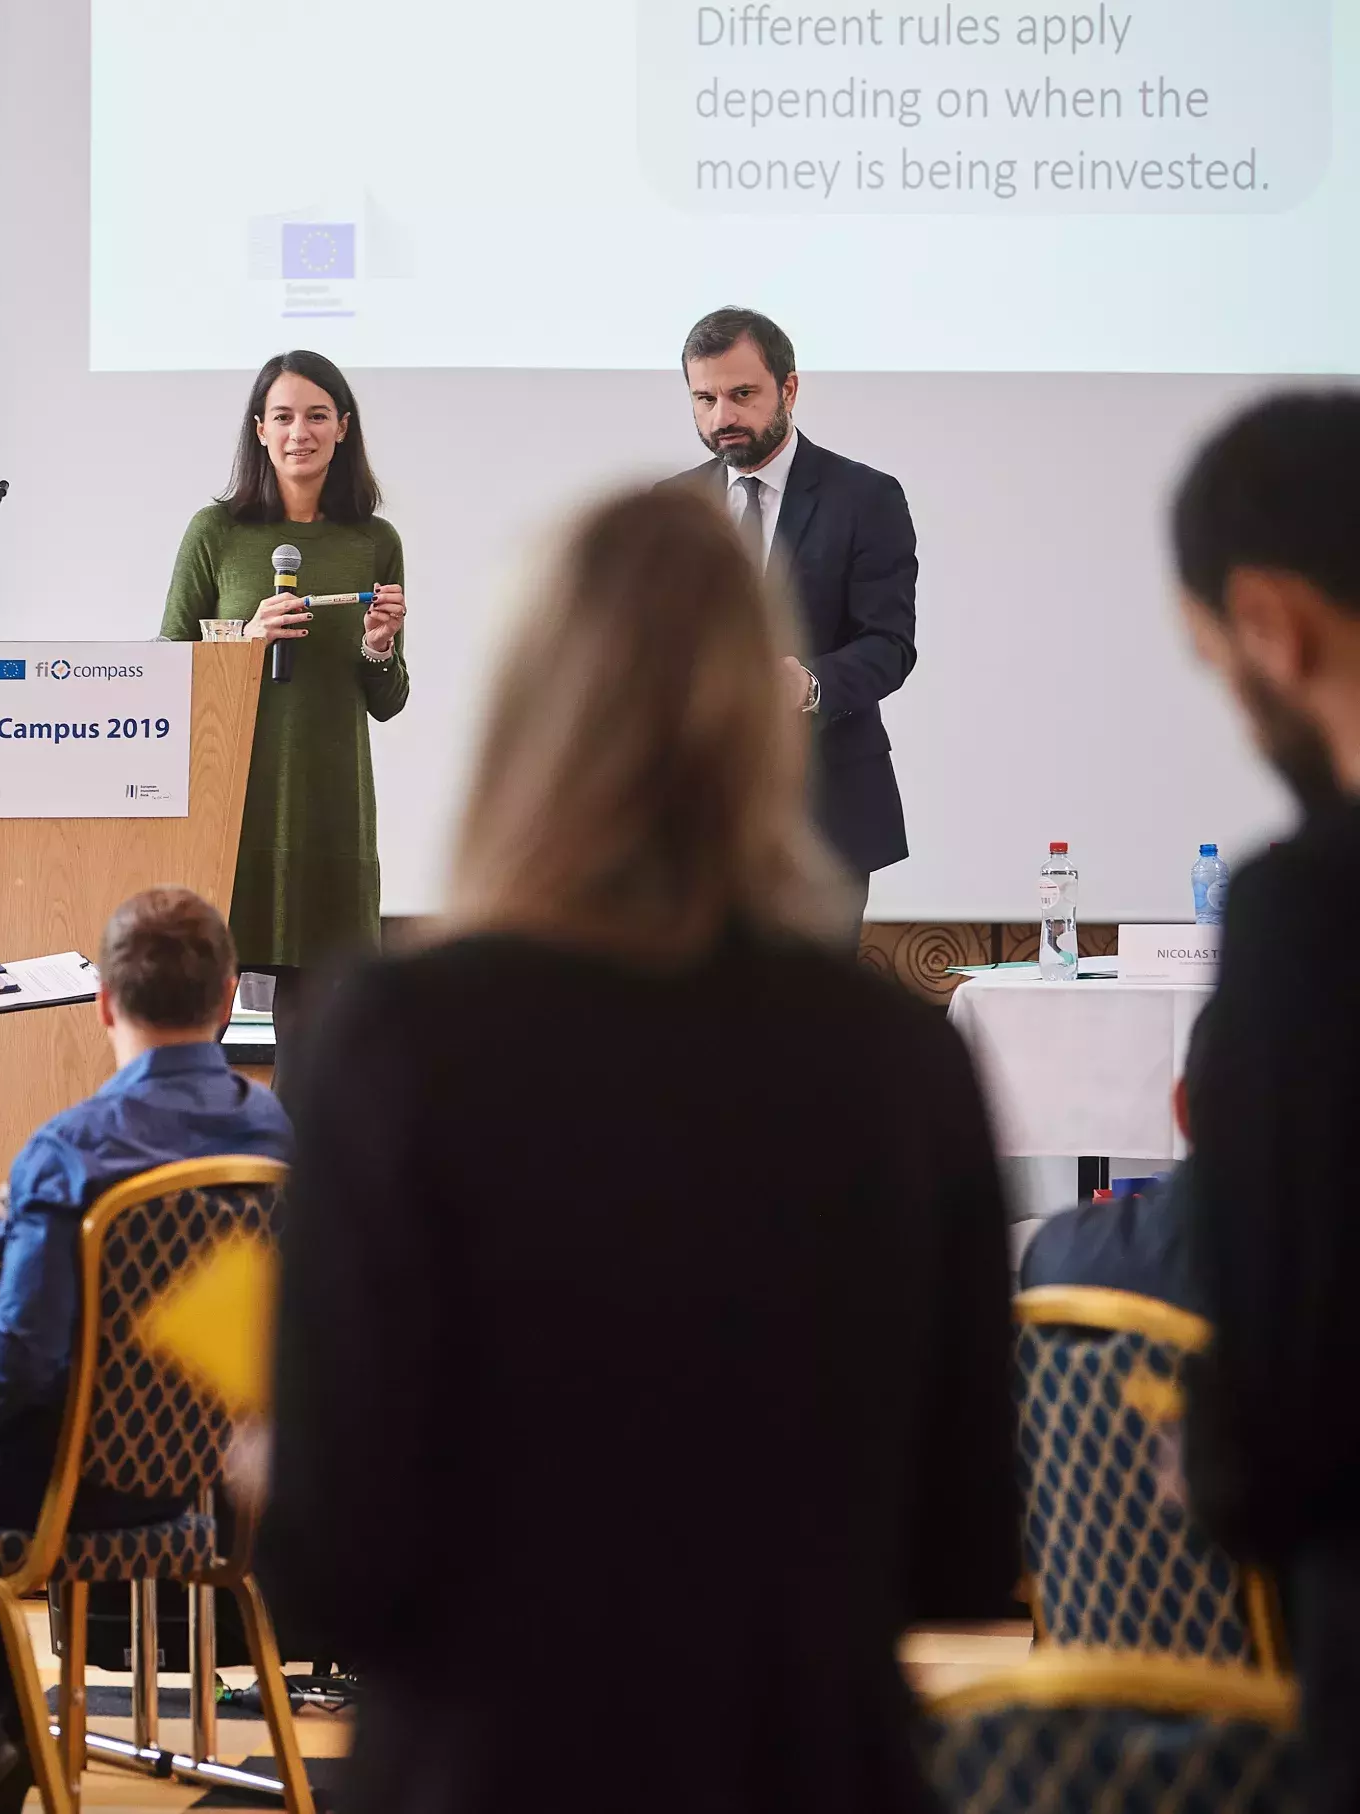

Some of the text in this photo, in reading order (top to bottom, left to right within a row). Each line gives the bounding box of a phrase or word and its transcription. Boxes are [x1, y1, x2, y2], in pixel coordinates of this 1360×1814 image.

[696, 2, 1132, 55] Different rules apply
[695, 76, 1210, 127] depending on when the
[696, 148, 1271, 198] money is being reinvested.
[73, 664, 143, 681] compass
[106, 717, 170, 739] 2019
[1157, 949, 1209, 959] NICOLAS
